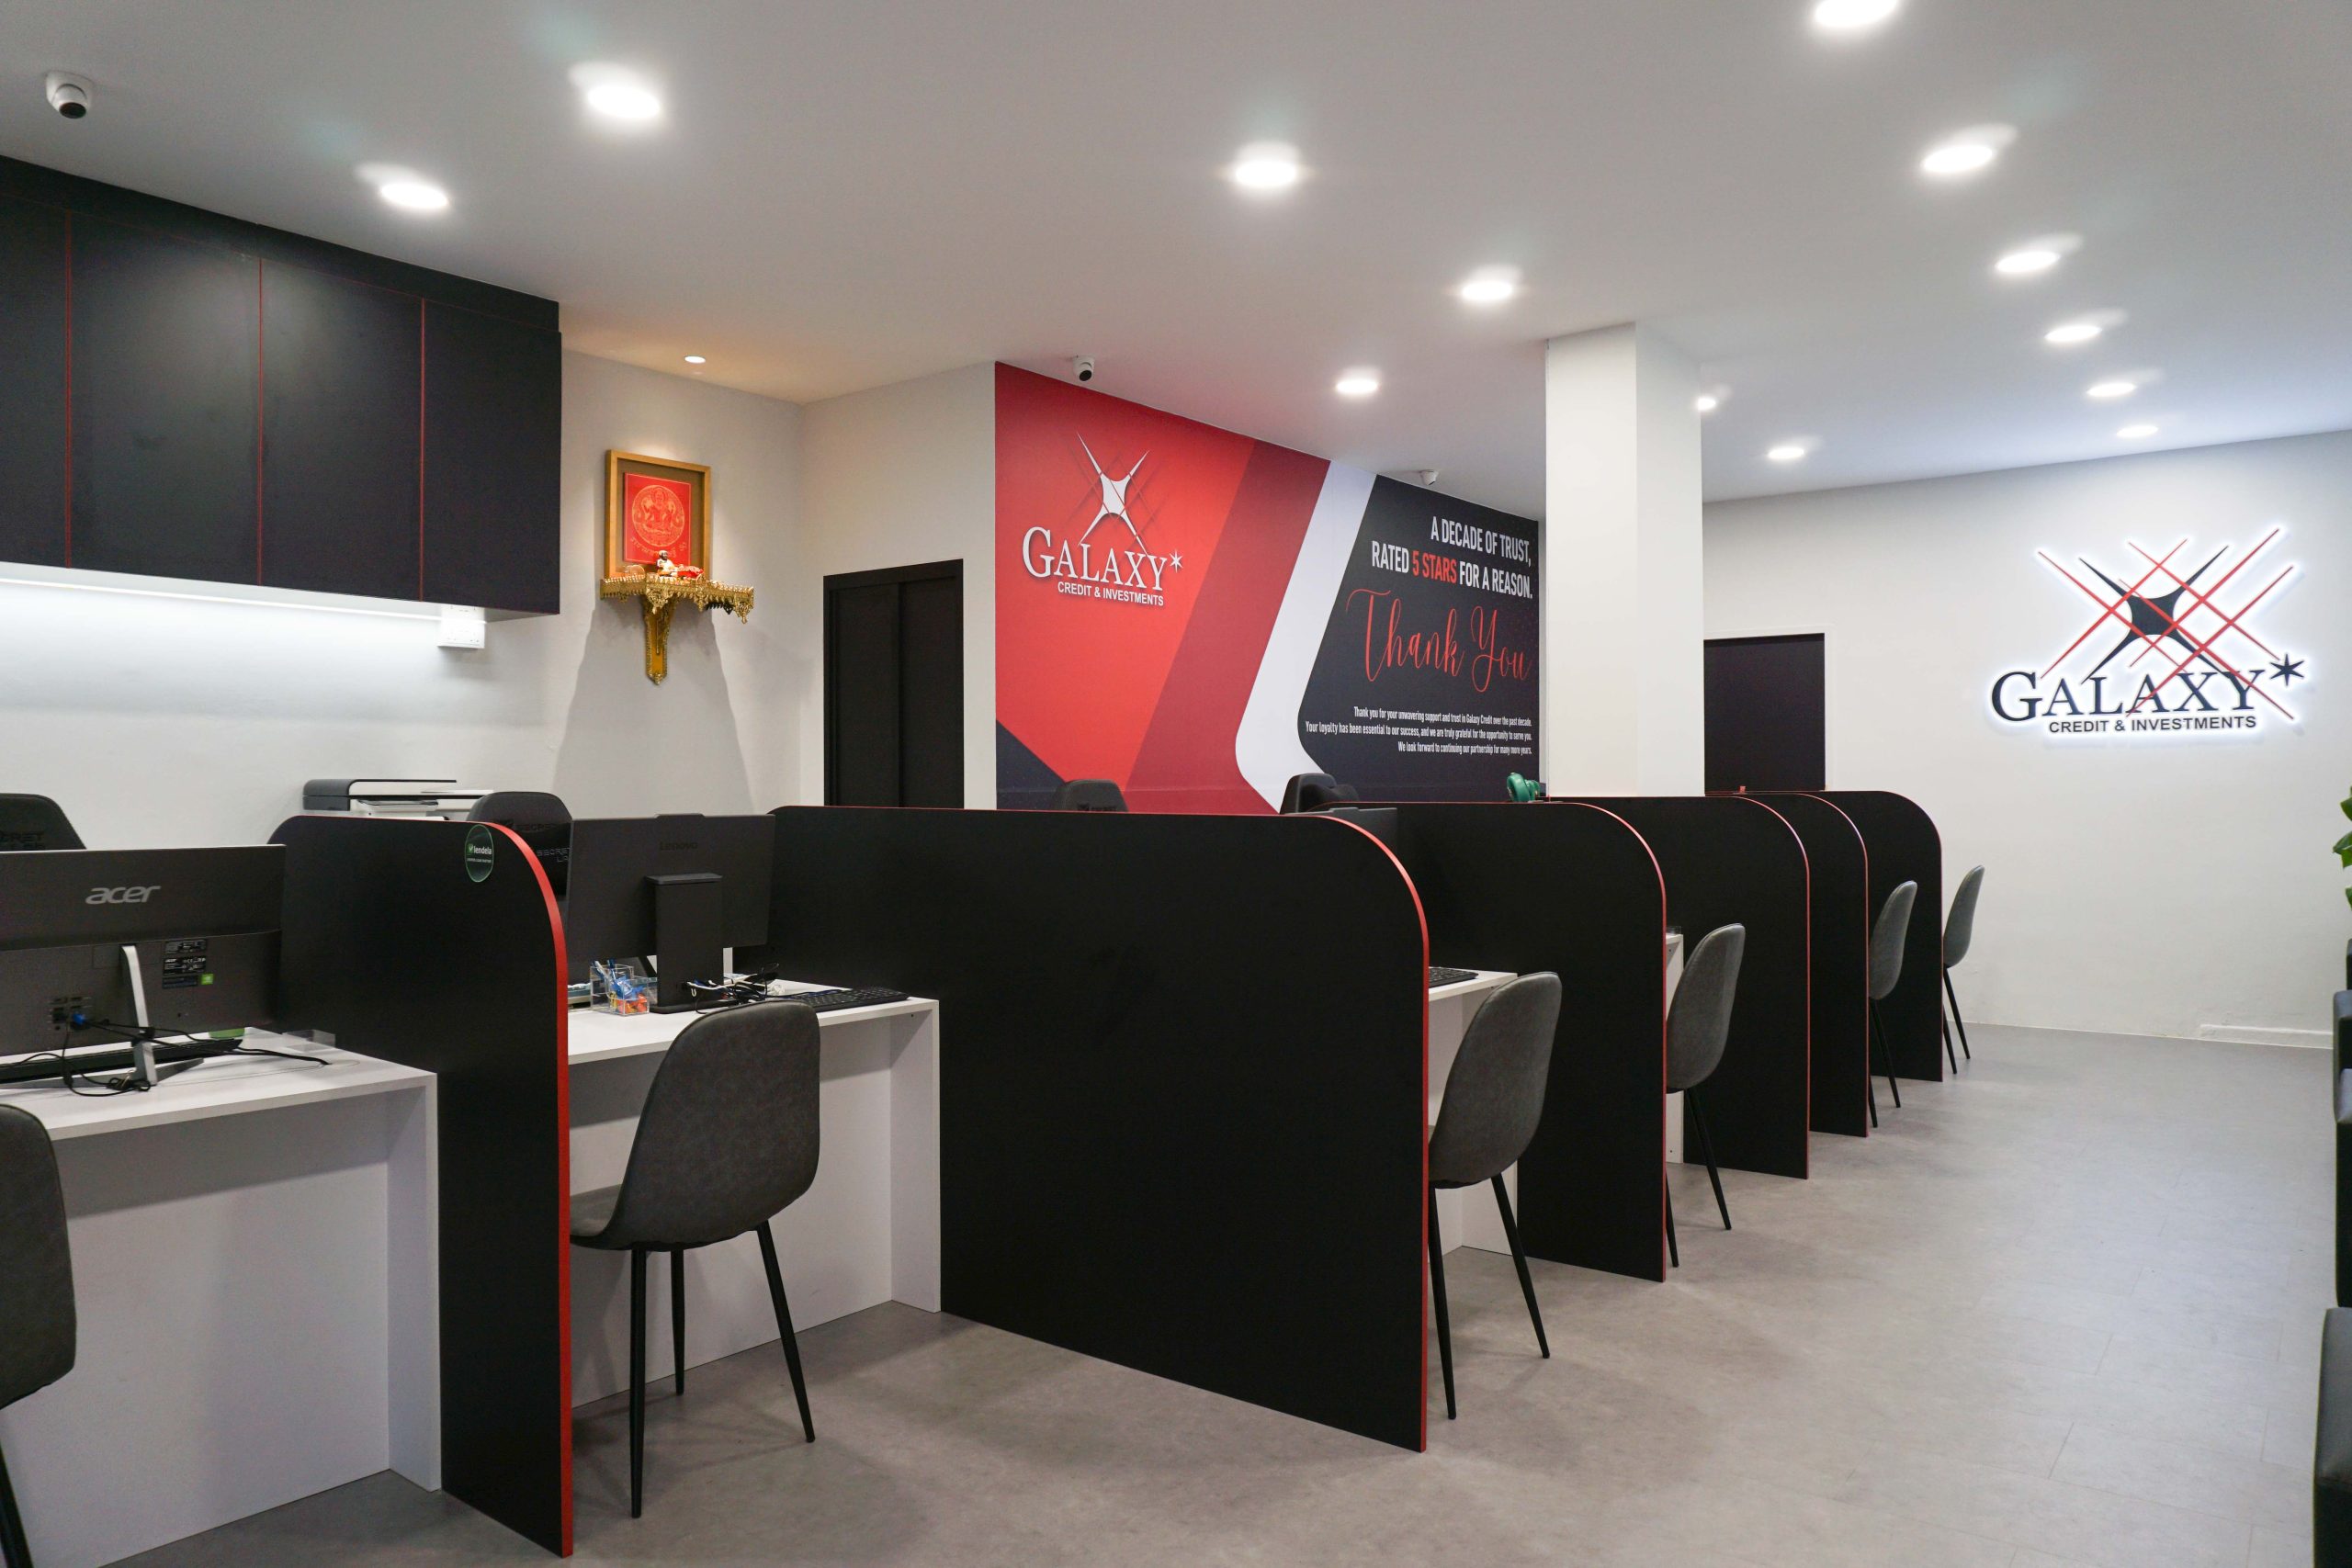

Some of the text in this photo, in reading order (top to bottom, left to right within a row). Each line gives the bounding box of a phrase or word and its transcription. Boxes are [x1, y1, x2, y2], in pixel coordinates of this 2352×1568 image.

[1430, 516, 1532, 567] A DECADE OF TRUST,
[1022, 526, 1168, 592] GALAXY
[1372, 540, 1532, 599] RATED 5 STARS FOR A REASON.
[1057, 581, 1164, 606] CREDIT & INVESTMENTS
[1346, 588, 1532, 693] Thank You
[1991, 669, 2266, 722] GALAXY
[1354, 706, 1368, 716] Thank
[1370, 710, 1378, 719] you
[1387, 710, 1397, 720] your
[1398, 711, 1424, 722] unwavering
[1425, 713, 1442, 722] support
[1451, 714, 1461, 722] trust
[1462, 714, 1465, 723] in
[1466, 714, 1480, 725] Galaxy
[1481, 715, 1492, 724] Credit
[2049, 716, 2256, 733] CREDIT & INVESTMENTS
[1306, 721, 1317, 732] Your
[1319, 722, 1338, 735] loyalty
[1340, 723, 1348, 733] has
[1350, 723, 1362, 733] been
[1363, 724, 1385, 734] essential
[1385, 726, 1390, 735] to
[1400, 727, 1419, 738] success,
[1430, 728, 1436, 737] we
[1444, 728, 1454, 739] truly
[1455, 728, 1472, 739] grateful
[1487, 731, 1508, 740] opportunity
[1398, 741, 1406, 751] We
[1407, 742, 1417, 751] look
[1417, 742, 1434, 752] forward
[1435, 743, 1440, 752] to
[1441, 743, 1462, 754] continuing
[1470, 745, 1493, 755] partnership
[1500, 746, 1510, 756] many
[85, 886, 161, 905] acer
